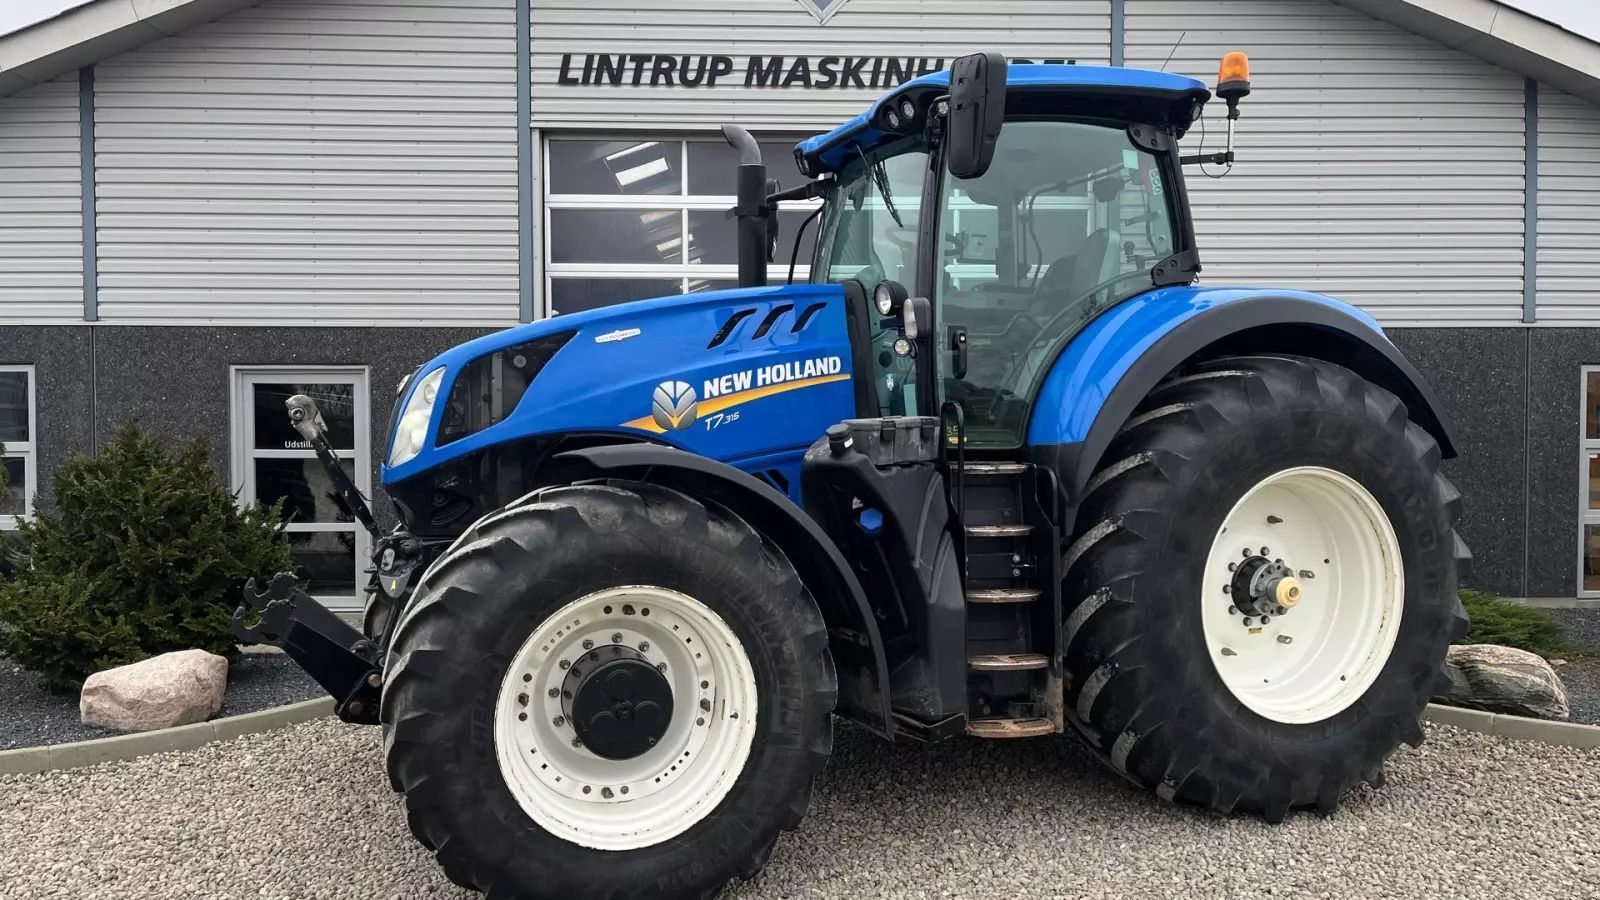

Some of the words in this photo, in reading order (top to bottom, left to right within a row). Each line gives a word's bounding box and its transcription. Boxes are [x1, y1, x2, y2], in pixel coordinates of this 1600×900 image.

[558, 54, 733, 87] LINTRUP
[703, 370, 753, 399] NEW
[757, 356, 842, 386] HOLLAND
